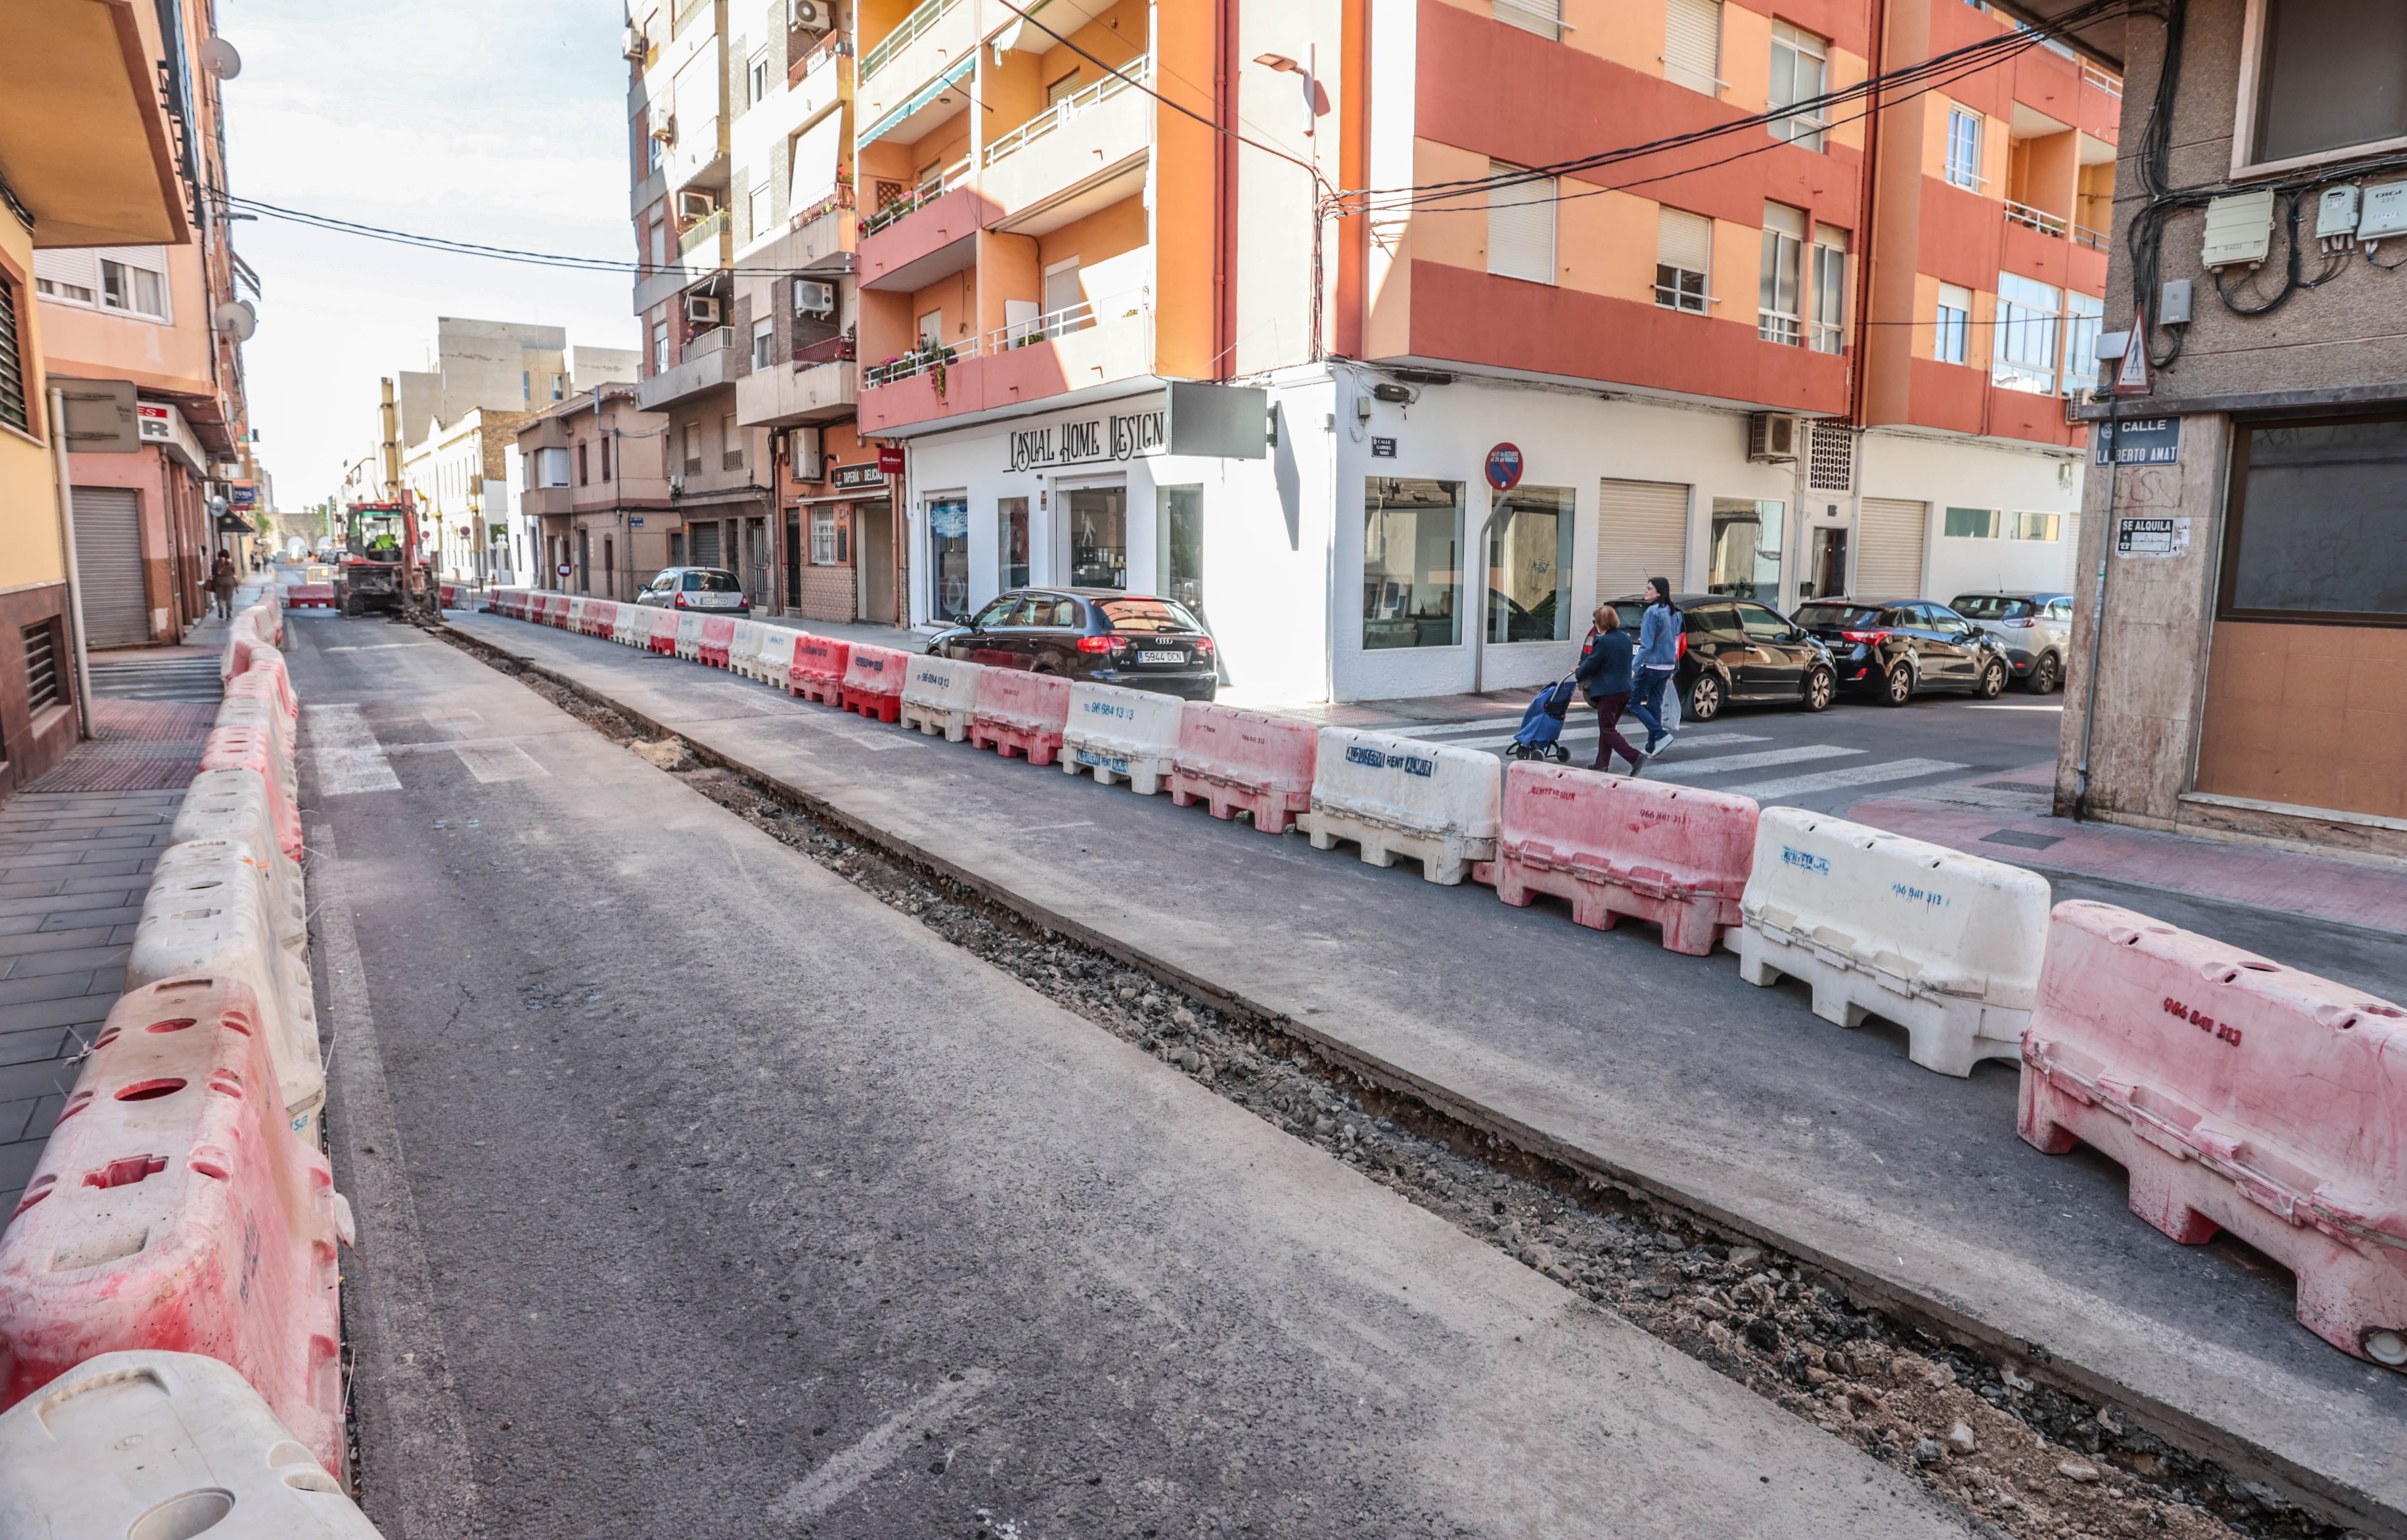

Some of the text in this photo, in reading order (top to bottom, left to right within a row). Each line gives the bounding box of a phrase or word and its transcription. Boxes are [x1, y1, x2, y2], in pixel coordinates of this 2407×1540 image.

[2122, 420, 2167, 432] CALLE
[1011, 412, 1164, 471] CASUAL HOME DESIGN
[2097, 447, 2176, 463] LABERTO AMAT
[843, 469, 859, 483] TAPERÍA
[864, 468, 882, 481] DELICIAS
[2122, 520, 2134, 530] SE
[2135, 520, 2170, 531] ALQUILA
[1145, 652, 1181, 661] 5944 DCN
[921, 673, 928, 682] 96
[928, 673, 936, 684] 684
[944, 678, 949, 687] 13
[1091, 701, 1101, 712] 96
[1101, 704, 1114, 715] 684
[1115, 706, 1124, 718] 13
[1346, 747, 1432, 777] ALQUISERVI RENT ALMUR
[2217, 1023, 2241, 1046] 313
